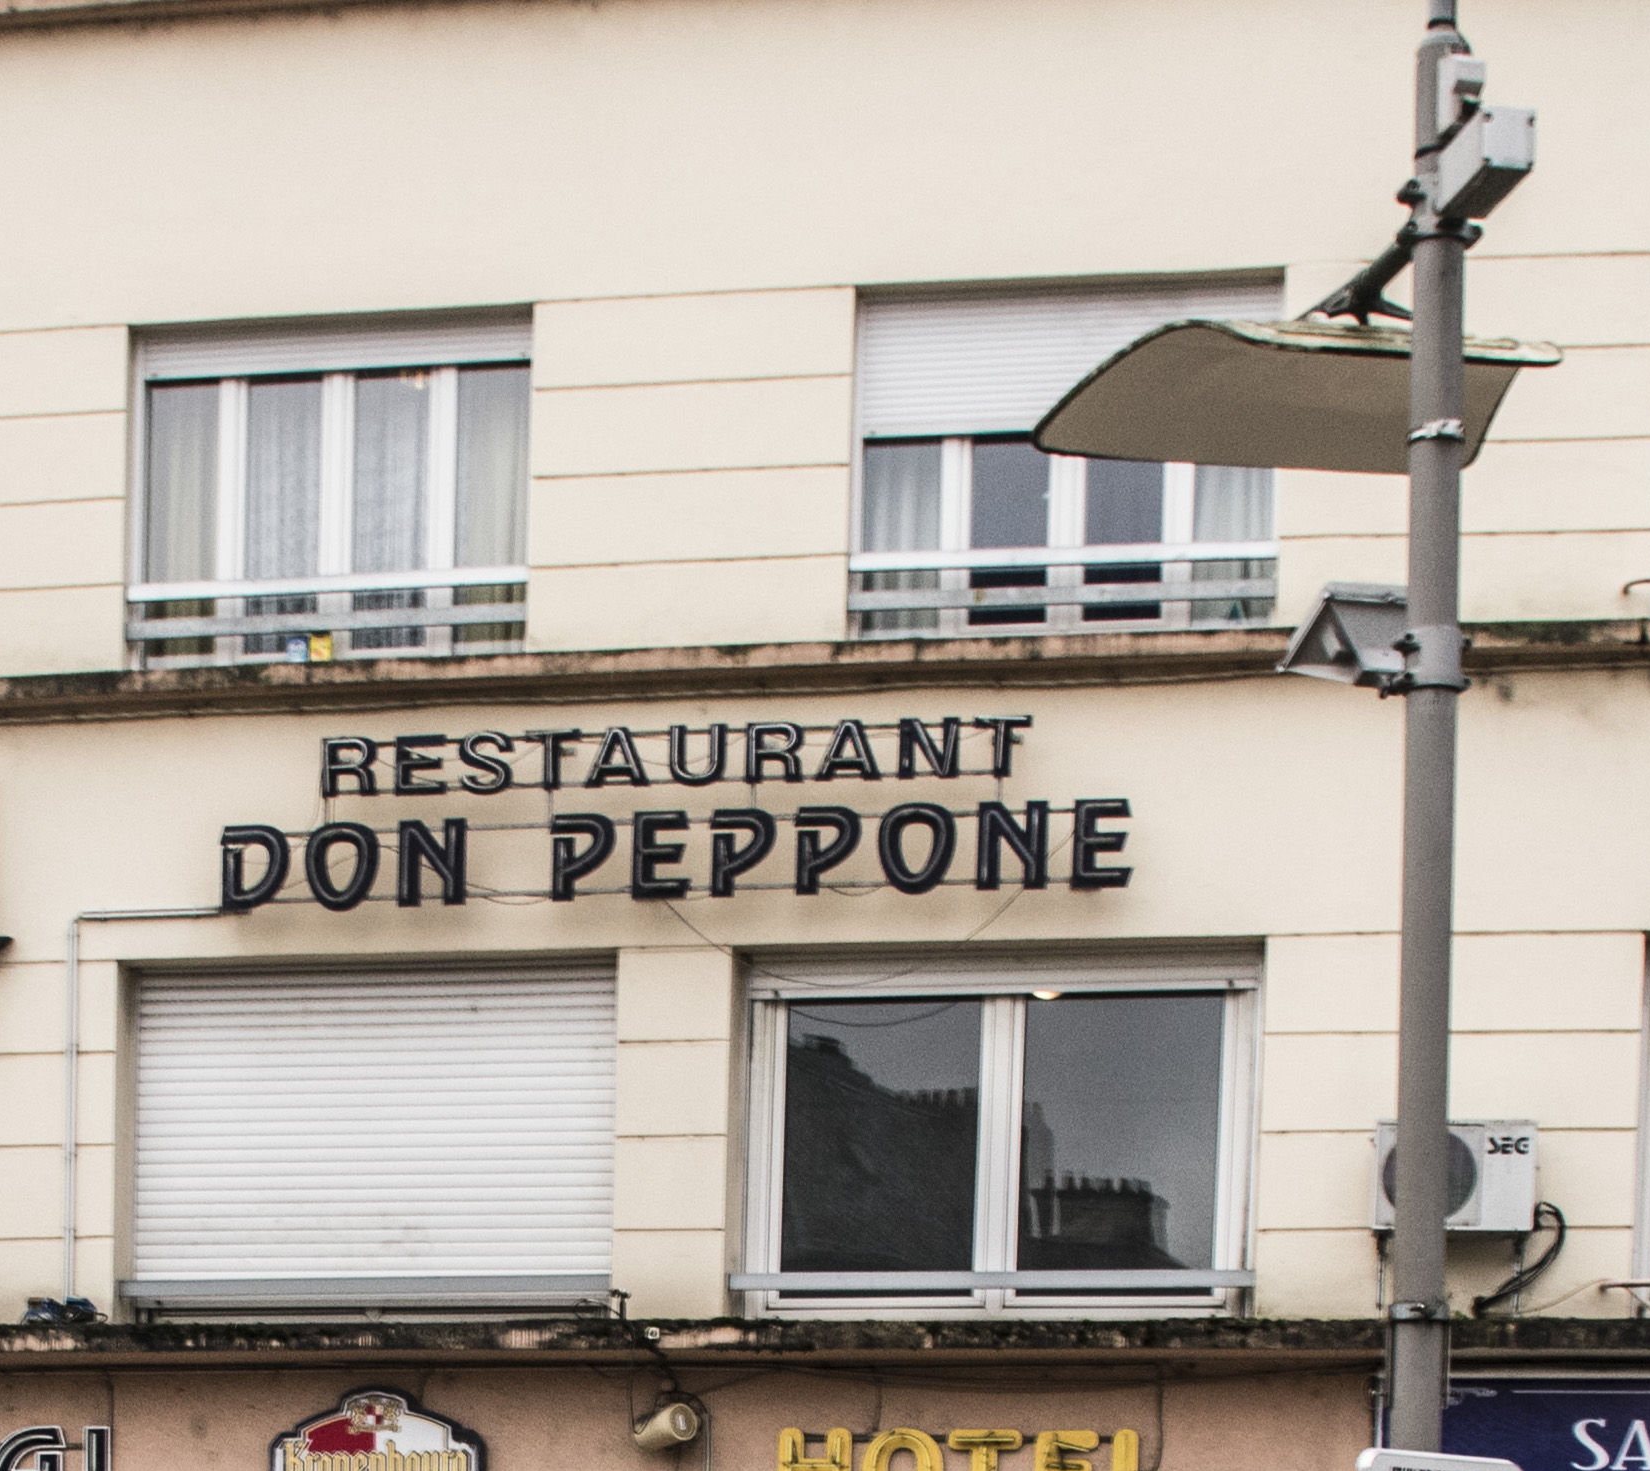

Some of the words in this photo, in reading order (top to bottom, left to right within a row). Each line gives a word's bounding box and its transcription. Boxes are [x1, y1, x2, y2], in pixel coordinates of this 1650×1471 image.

[320, 715, 1033, 798] RESTAURANT
[221, 816, 468, 913] DON
[551, 798, 1134, 902] PEPPONE
